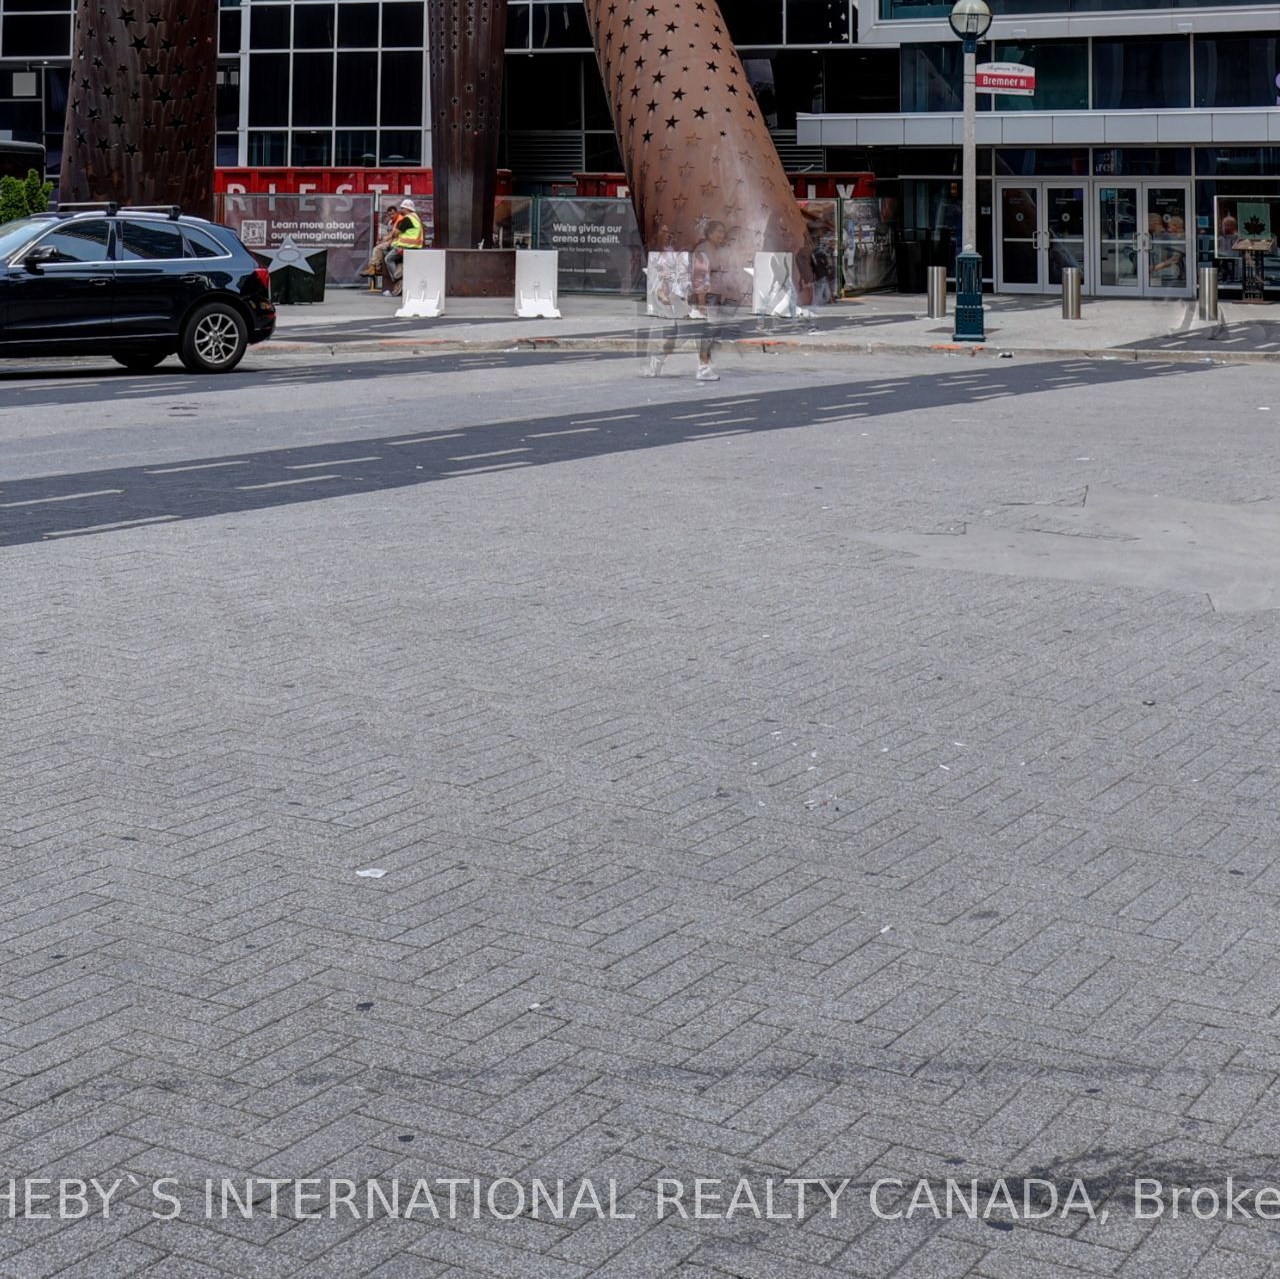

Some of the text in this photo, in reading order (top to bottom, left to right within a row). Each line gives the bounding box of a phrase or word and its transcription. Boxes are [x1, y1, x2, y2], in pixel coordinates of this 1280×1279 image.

[982, 75, 1018, 87] Bremner
[271, 221, 298, 229] Learn
[325, 221, 355, 229] about
[552, 223, 622, 234] We're giving our
[288, 230, 355, 241] reimagination
[552, 234, 578, 243] arena
[587, 234, 620, 244] facelift.
